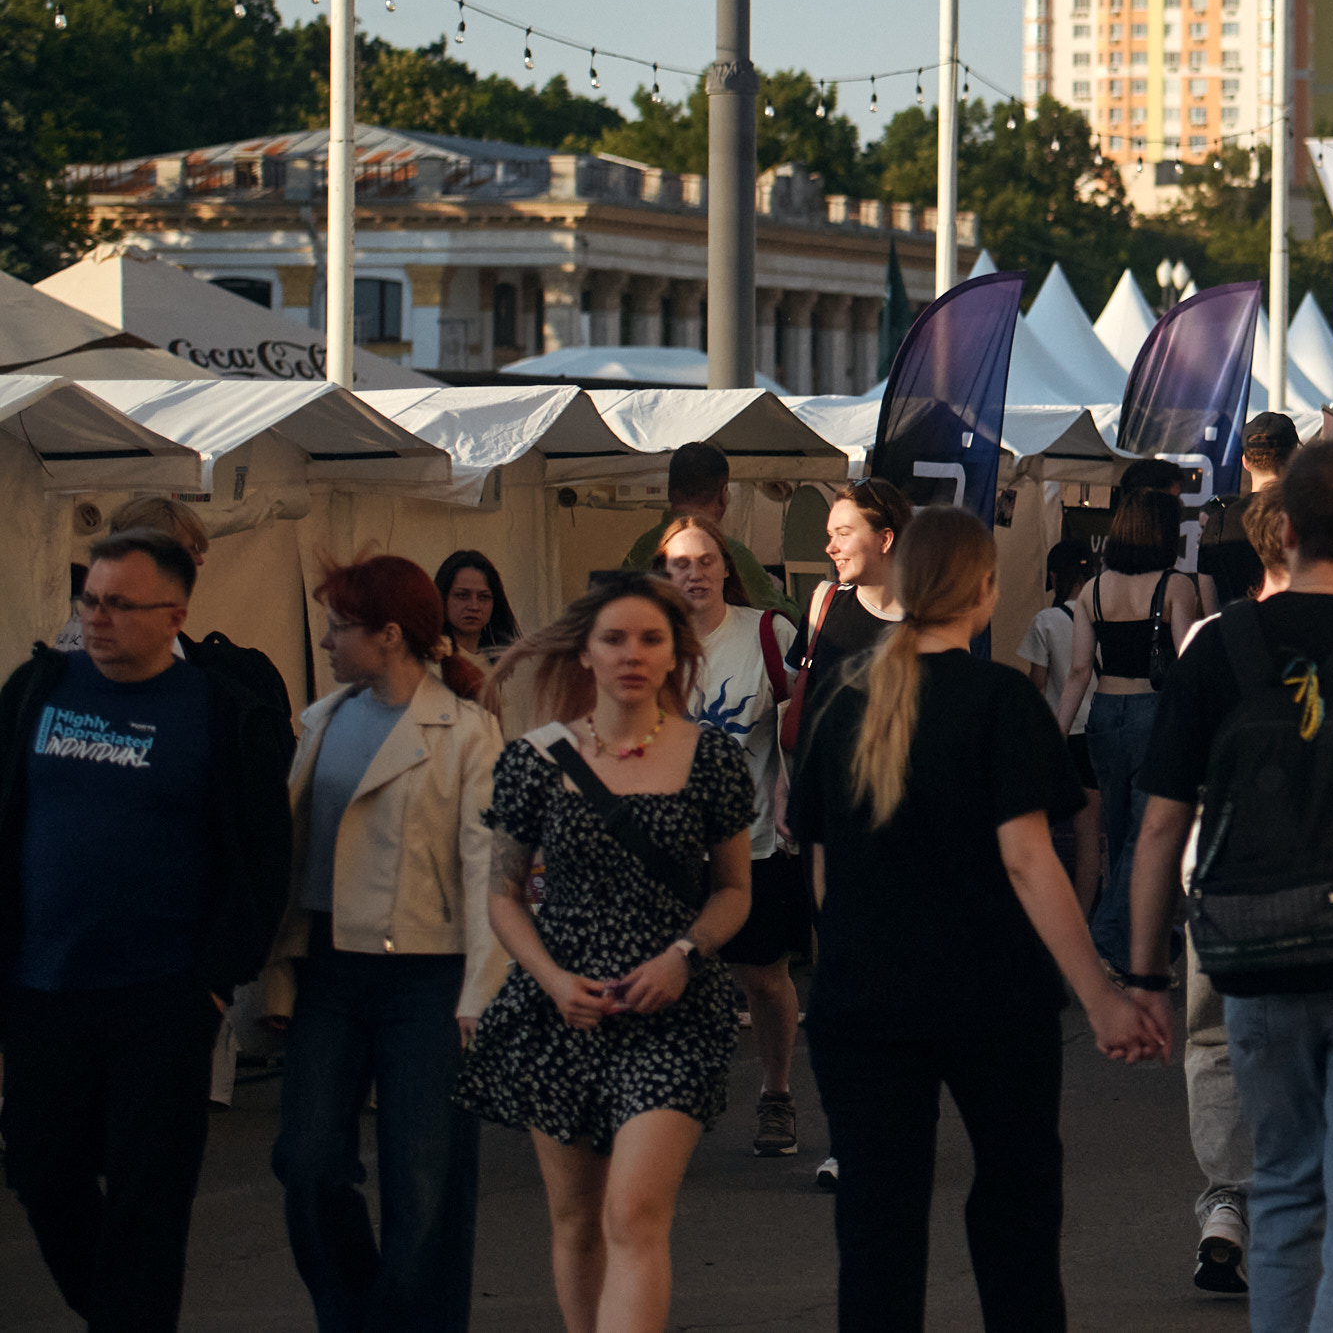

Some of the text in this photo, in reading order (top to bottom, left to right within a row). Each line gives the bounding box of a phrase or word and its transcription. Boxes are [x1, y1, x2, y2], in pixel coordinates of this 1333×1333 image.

[167, 337, 358, 384] Coca-Col
[55, 707, 111, 733] Highly
[51, 721, 154, 750] Appreciated
